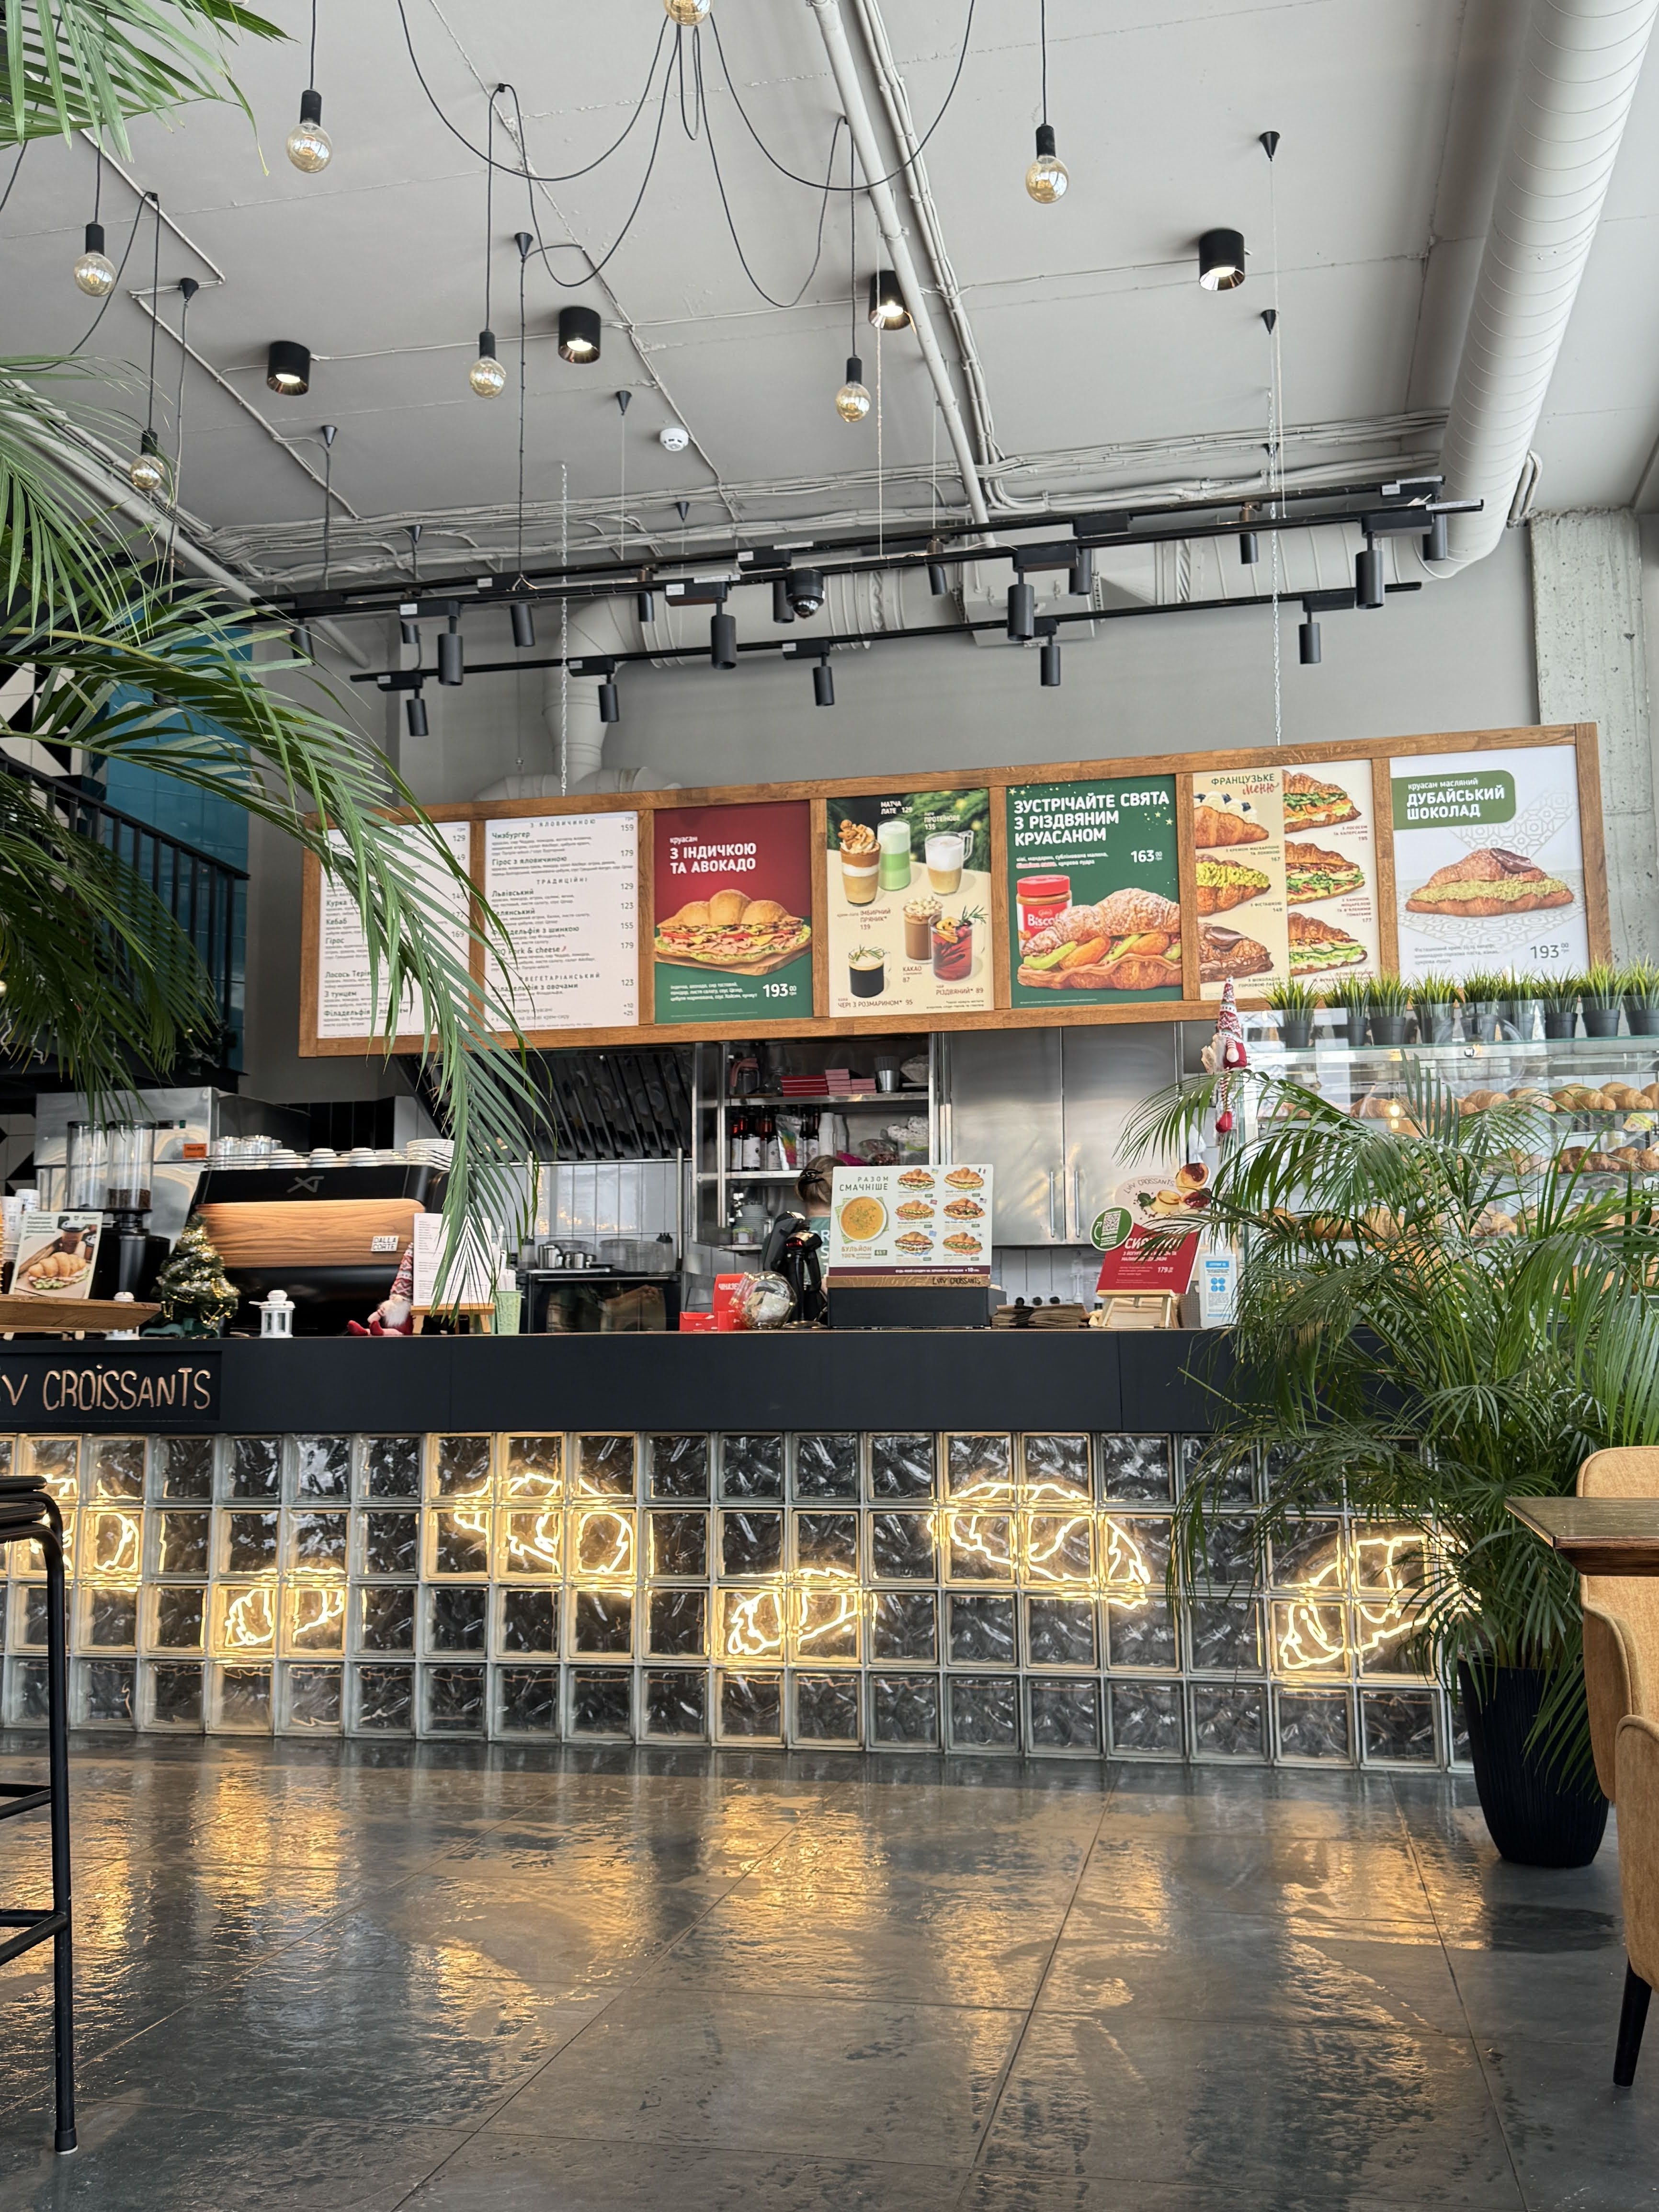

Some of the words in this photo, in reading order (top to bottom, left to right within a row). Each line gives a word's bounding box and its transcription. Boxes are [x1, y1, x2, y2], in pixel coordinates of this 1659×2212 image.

[1211, 773, 1274, 785] ФРАНЦУЗЬКЕ
[1408, 783, 1437, 791] круасан
[1440, 778, 1478, 787] масляний
[1014, 793, 1115, 814] ЗУСТРІЧАЙТЕ
[1120, 791, 1170, 807] СВЯТА
[1407, 785, 1505, 808] ДУБАЙСЬКИЙ
[1407, 804, 1481, 820] ШОКОЛАД
[539, 819, 596, 827] ЯЛОВИЧИНОЮ
[1014, 816, 1024, 830] З
[1029, 810, 1119, 830] РІЗДВЯНИМ
[492, 831, 530, 839] Чизбургер
[670, 836, 698, 845] круасан
[1015, 827, 1106, 846] КРУАСАНОМ
[670, 847, 678, 859] З
[683, 843, 756, 859] ІНДИЧКОЮ
[1130, 850, 1154, 862] 163
[492, 858, 511, 867] Гірос
[670, 862, 687, 874] ТА
[691, 858, 756, 873] АВОКАДО
[492, 889, 534, 897] Львівський
[326, 900, 347, 908] Курка
[325, 937, 345, 945] Гірос
[1530, 945, 1559, 959] 193
[525, 972, 600, 982] ВЕГЕТАРІАНСЬКИЙ
[762, 983, 788, 997] 193
[839, 1183, 888, 1191] СМАЧНІШЕ
